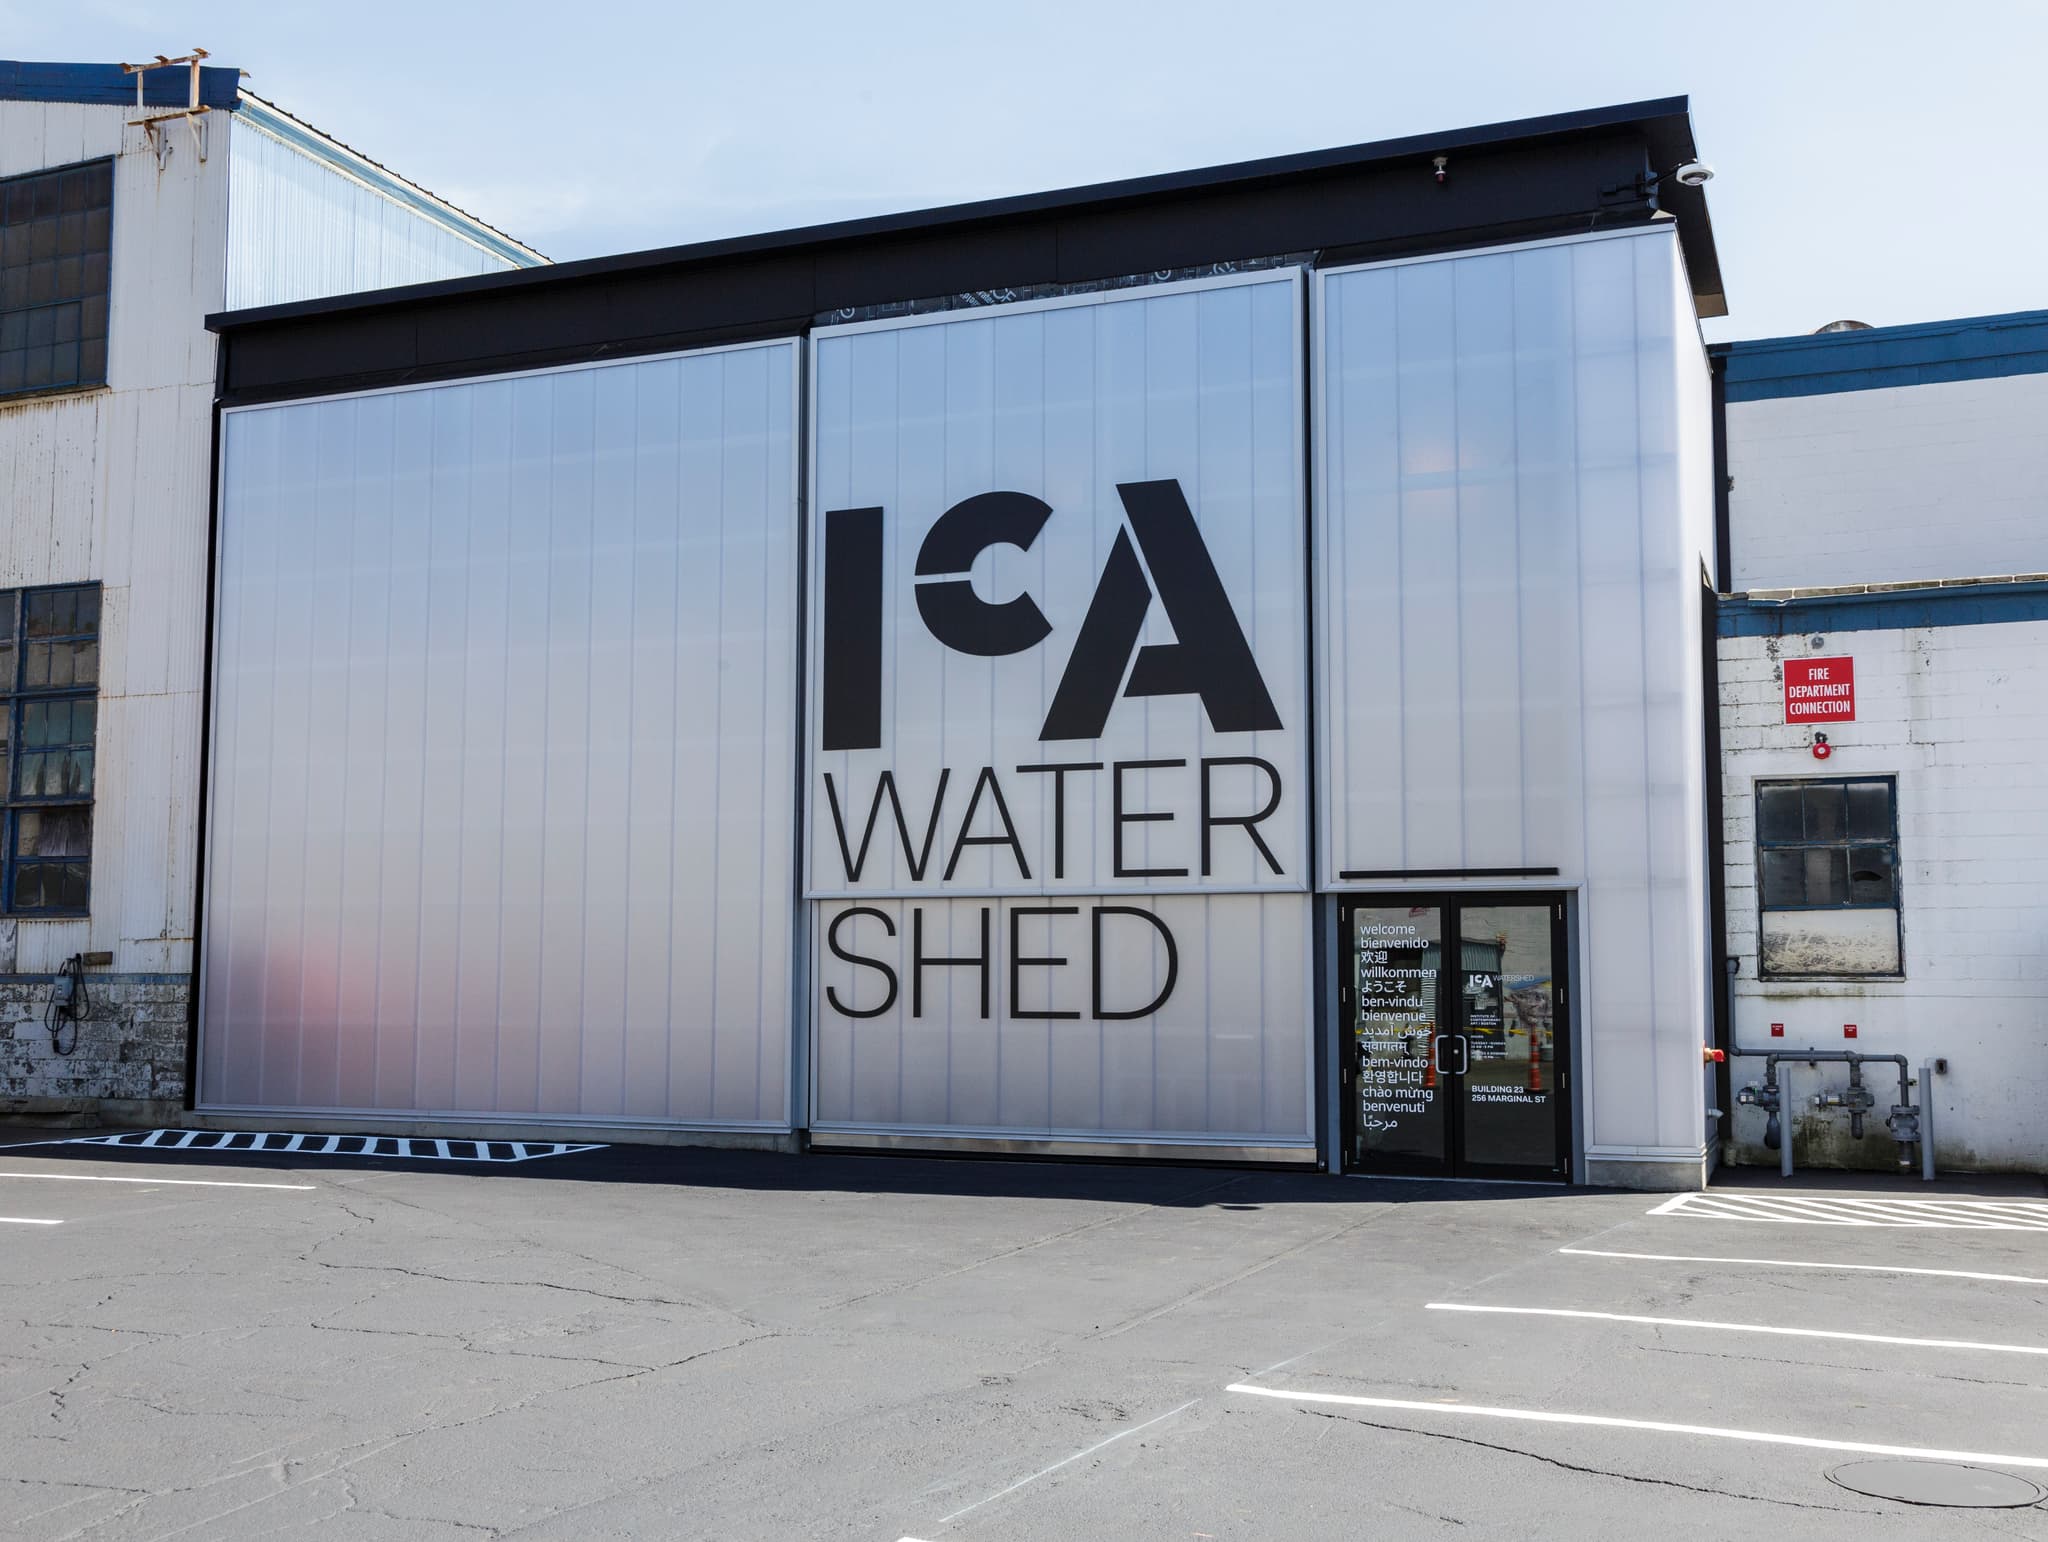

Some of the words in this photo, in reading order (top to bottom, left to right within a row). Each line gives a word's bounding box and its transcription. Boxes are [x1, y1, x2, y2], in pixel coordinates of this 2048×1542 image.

[823, 478, 1284, 751] ICA
[1808, 667, 1830, 681] FIRE
[1788, 683, 1851, 698] DEPARTMENT
[1789, 700, 1851, 715] CONNECTION
[823, 756, 1285, 883] WATER
[1360, 923, 1416, 935] welcome
[1360, 937, 1429, 949] bienvenido
[826, 906, 1179, 1021] SHED
[1361, 950, 1388, 964] 欢迎
[1360, 966, 1437, 978] willkommen
[1361, 980, 1407, 993] ようこそ
[1469, 974, 1494, 988] ICA
[1361, 995, 1423, 1007] ben-vindu
[1361, 1009, 1426, 1021] bienvenue
[1362, 1056, 1428, 1068] bem-vindo
[1362, 1070, 1423, 1084] 환영합니다
[1362, 1085, 1392, 1097] chào
[1471, 1085, 1512, 1093] BUILDING
[1471, 1094, 1486, 1102] 256
[1487, 1094, 1534, 1103] MARGINAL
[1534, 1095, 1546, 1103] ST
[1363, 1099, 1425, 1112] benvenuti
